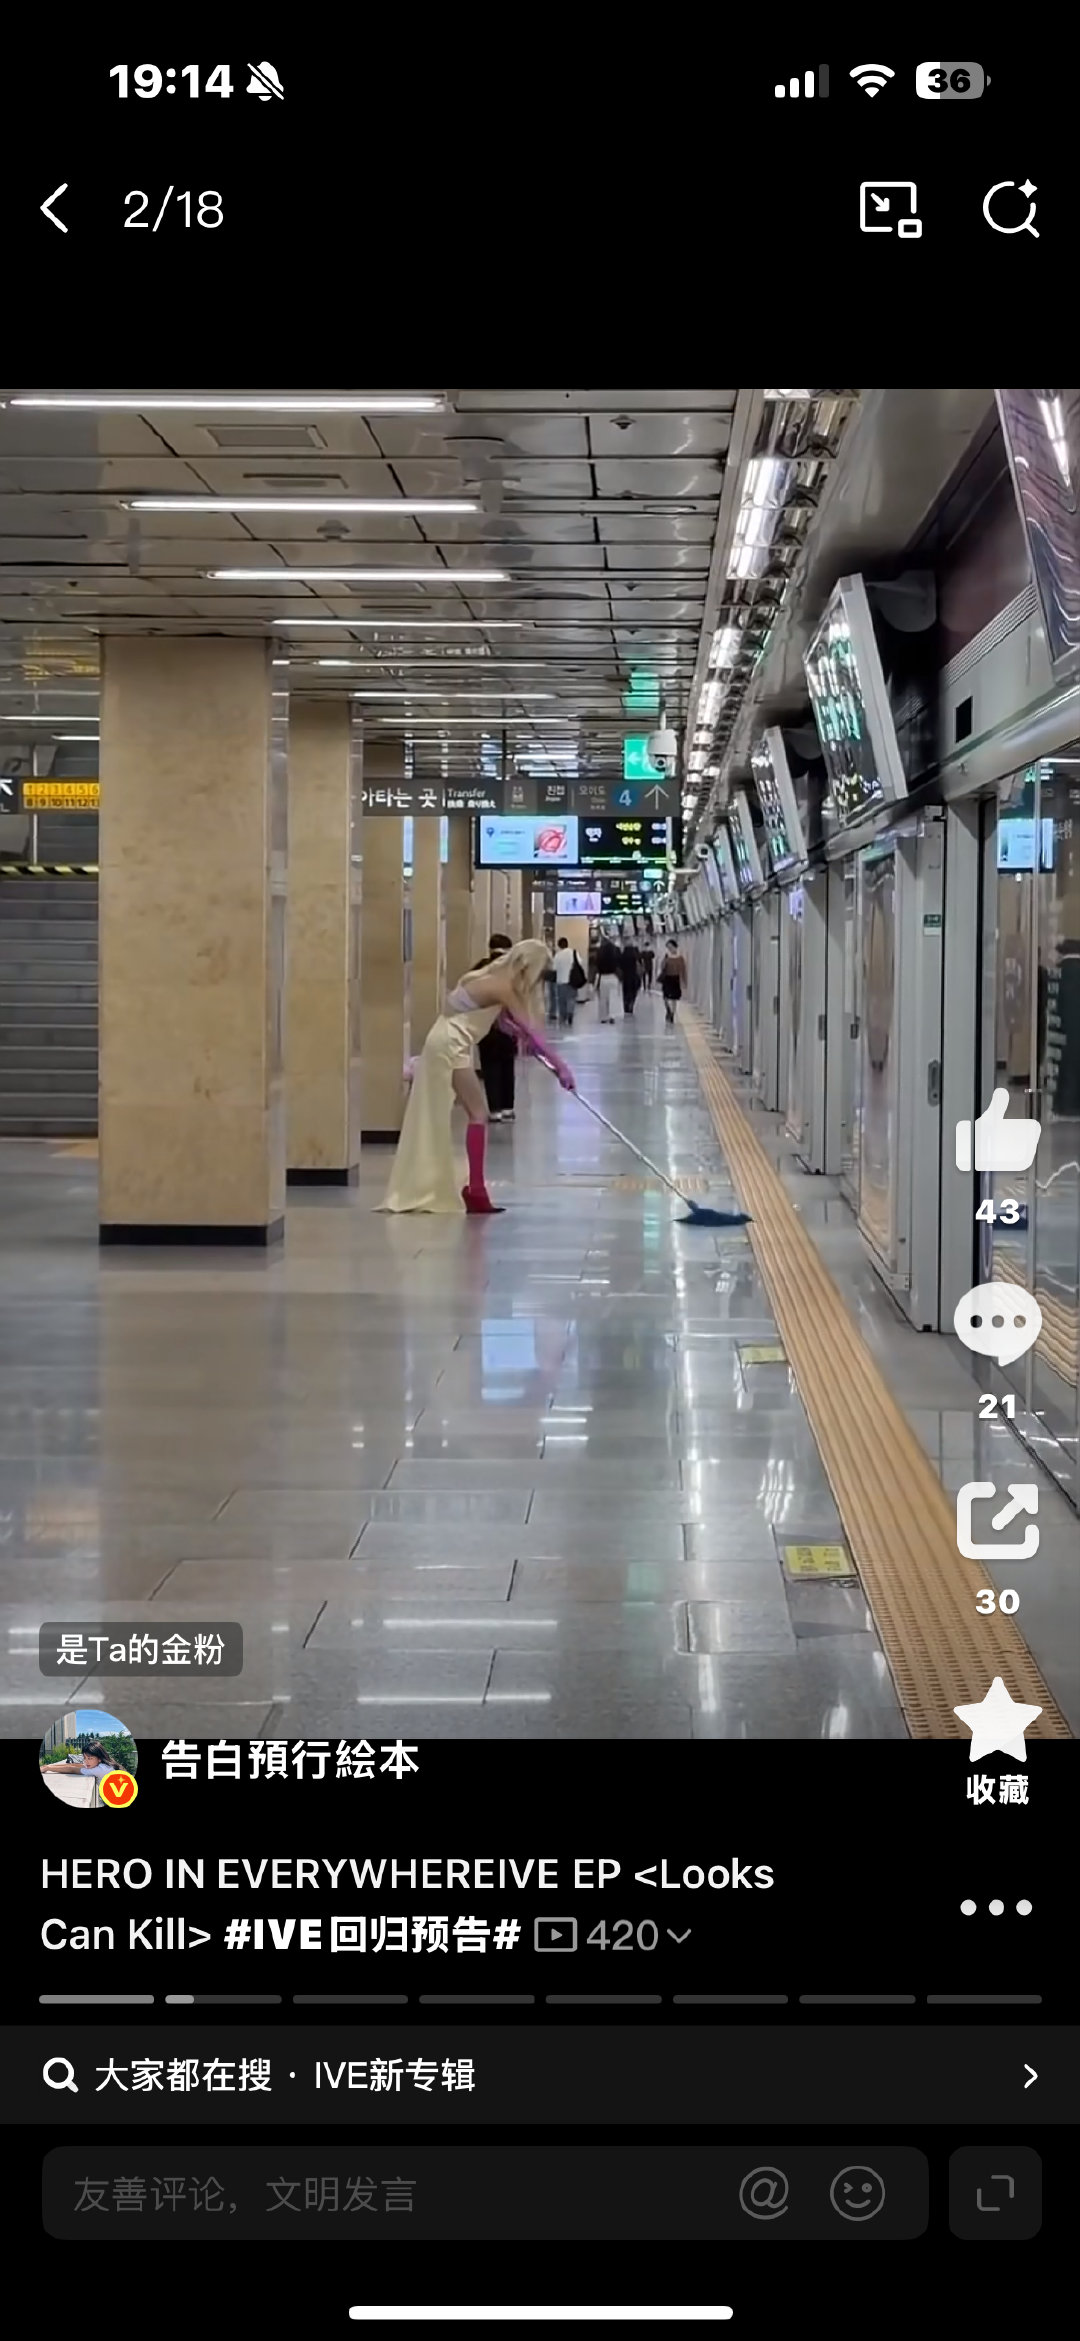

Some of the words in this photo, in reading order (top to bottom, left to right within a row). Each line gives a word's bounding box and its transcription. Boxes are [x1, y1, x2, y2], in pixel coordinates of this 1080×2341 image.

[418, 787, 437, 808] 곳
[447, 787, 486, 798] Transfer
[619, 789, 632, 807] 4
